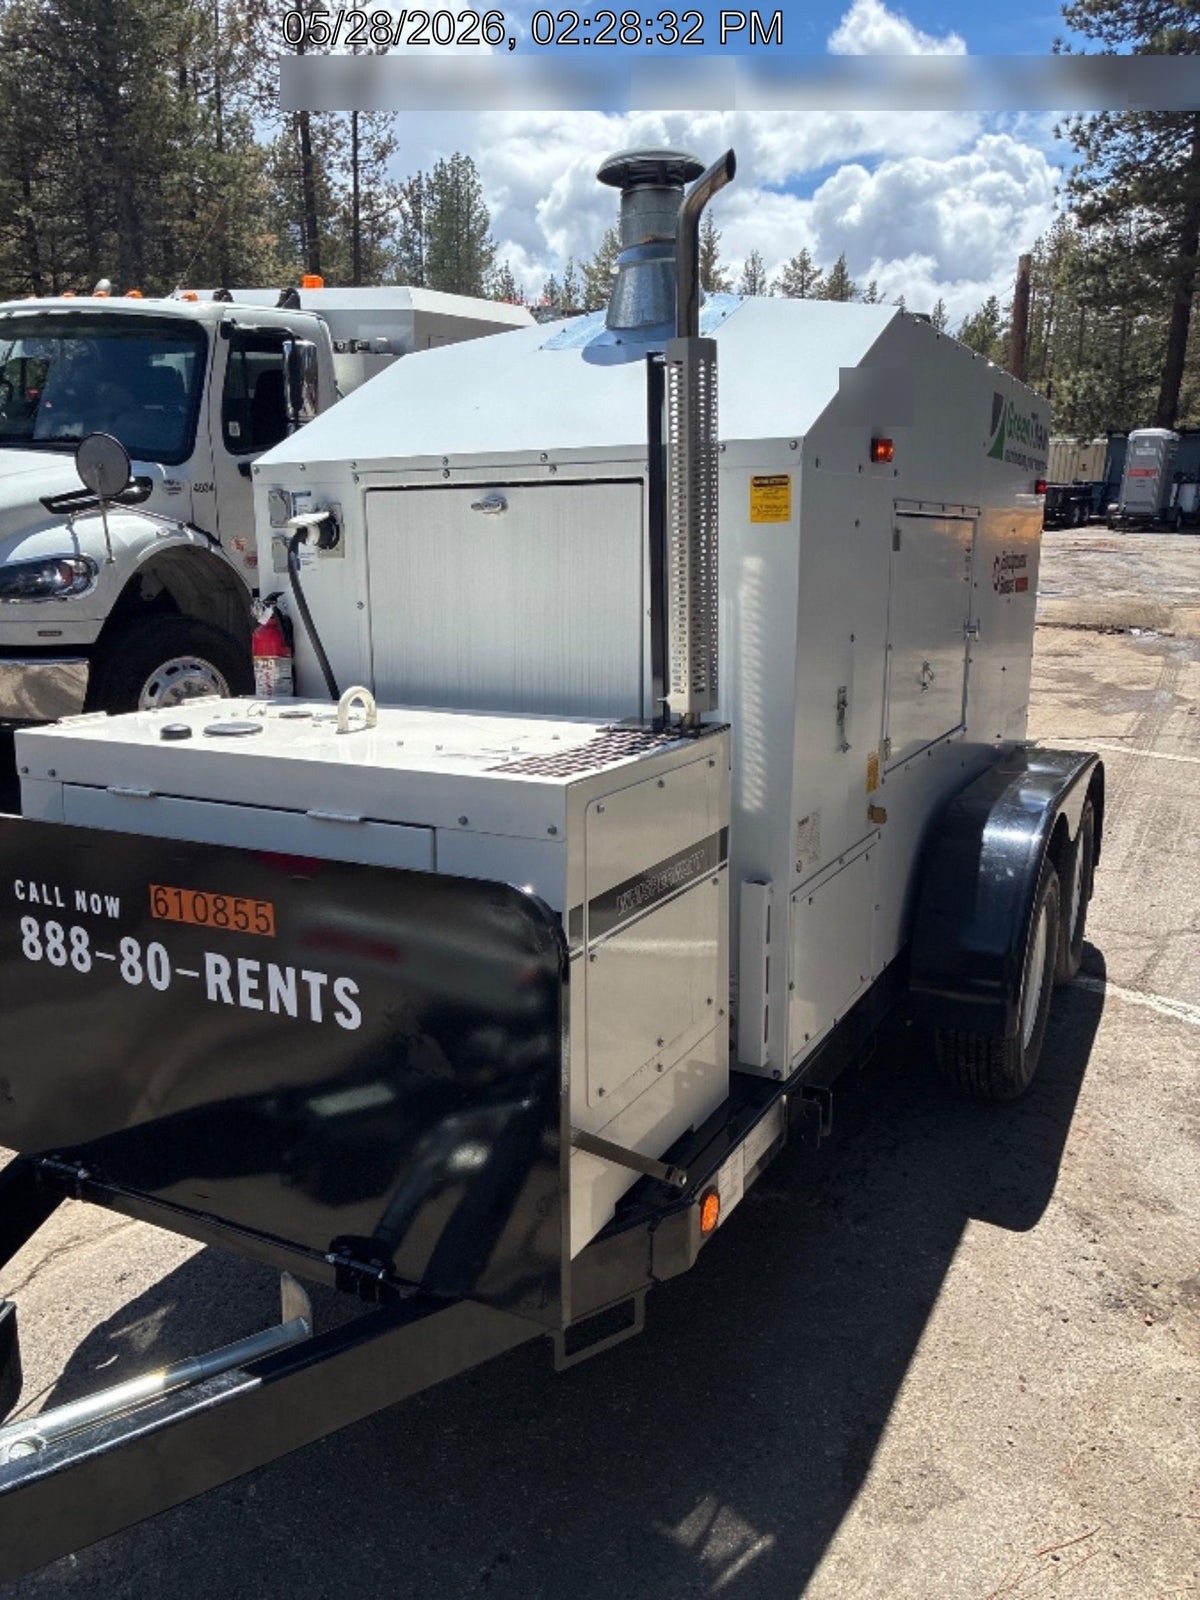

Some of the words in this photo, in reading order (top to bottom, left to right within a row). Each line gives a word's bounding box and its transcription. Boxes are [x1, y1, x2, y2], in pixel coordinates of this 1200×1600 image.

[14, 879, 65, 908] CALL
[75, 890, 120, 919] NOW
[153, 886, 271, 934] 610855
[20, 916, 362, 1031] 888-80-RENTS
